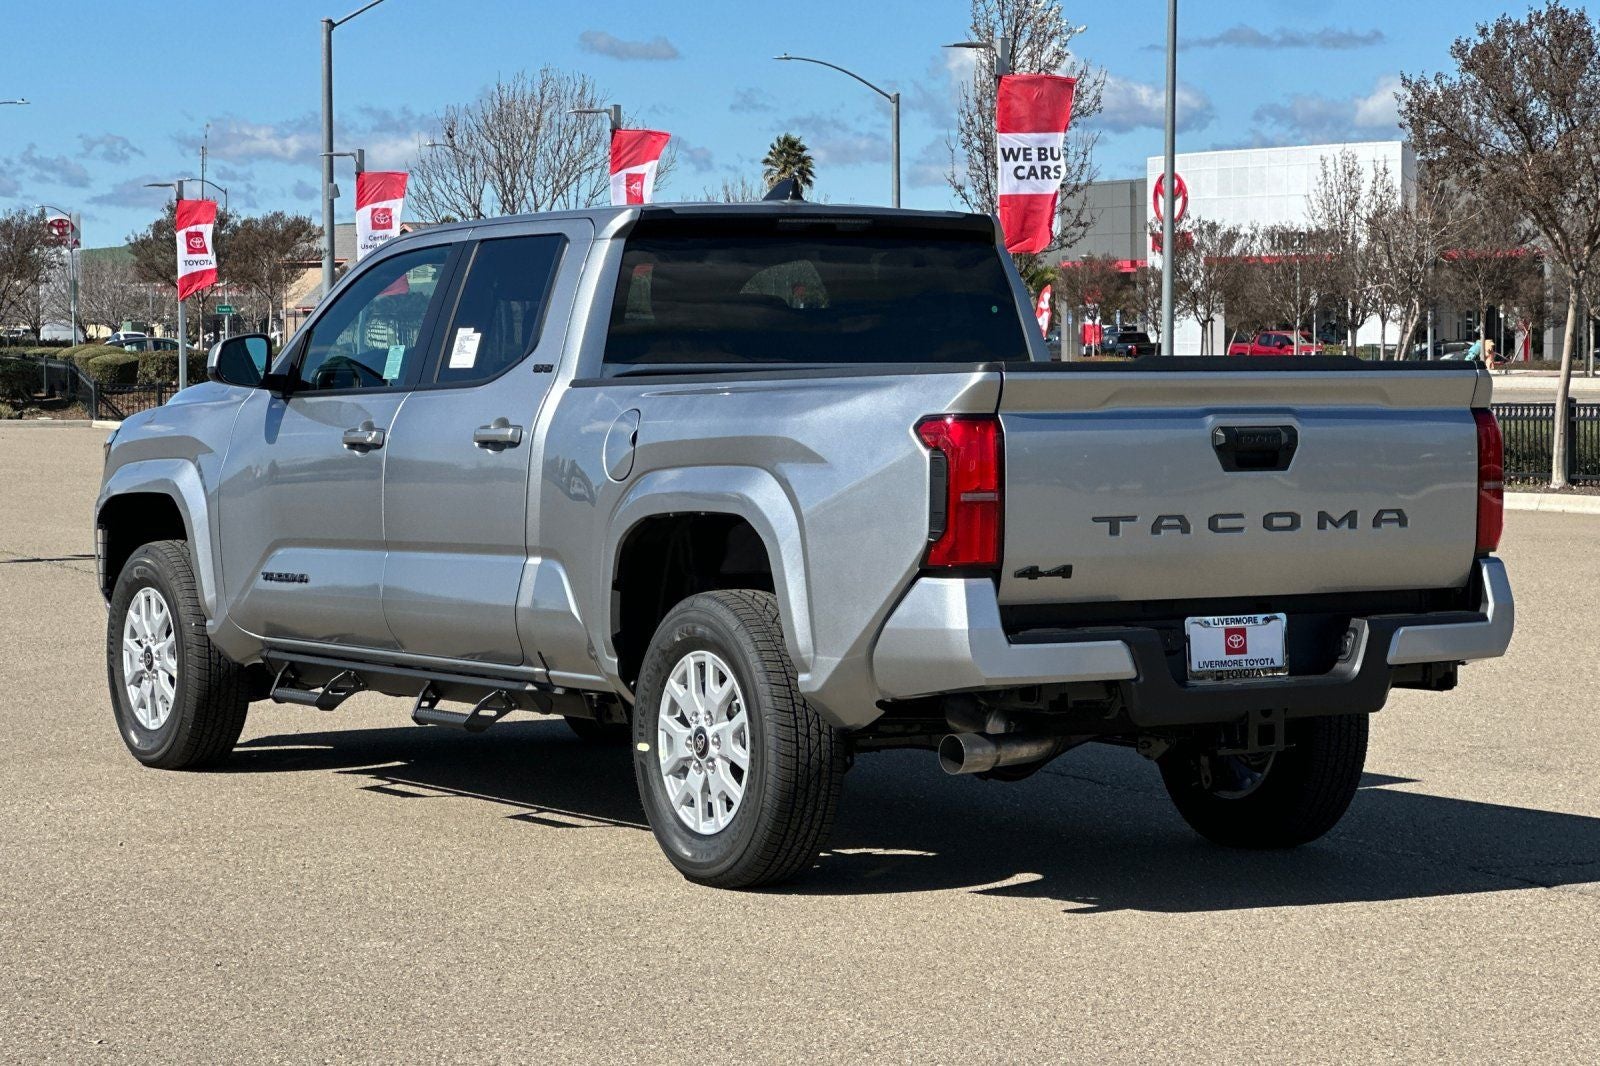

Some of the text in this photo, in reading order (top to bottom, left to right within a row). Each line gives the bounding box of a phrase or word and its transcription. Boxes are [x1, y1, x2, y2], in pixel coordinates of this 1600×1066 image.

[1001, 146, 1061, 162] WE BU
[1013, 164, 1062, 180] CARS
[368, 233, 395, 241] Certifi
[184, 259, 213, 267] TOYOTA
[1092, 508, 1409, 537] TACOMA
[1212, 616, 1259, 626] LIVERMORE
[1198, 657, 1275, 669] LIVERMORE TOYOTA
[1226, 668, 1262, 679] TOYOTA
